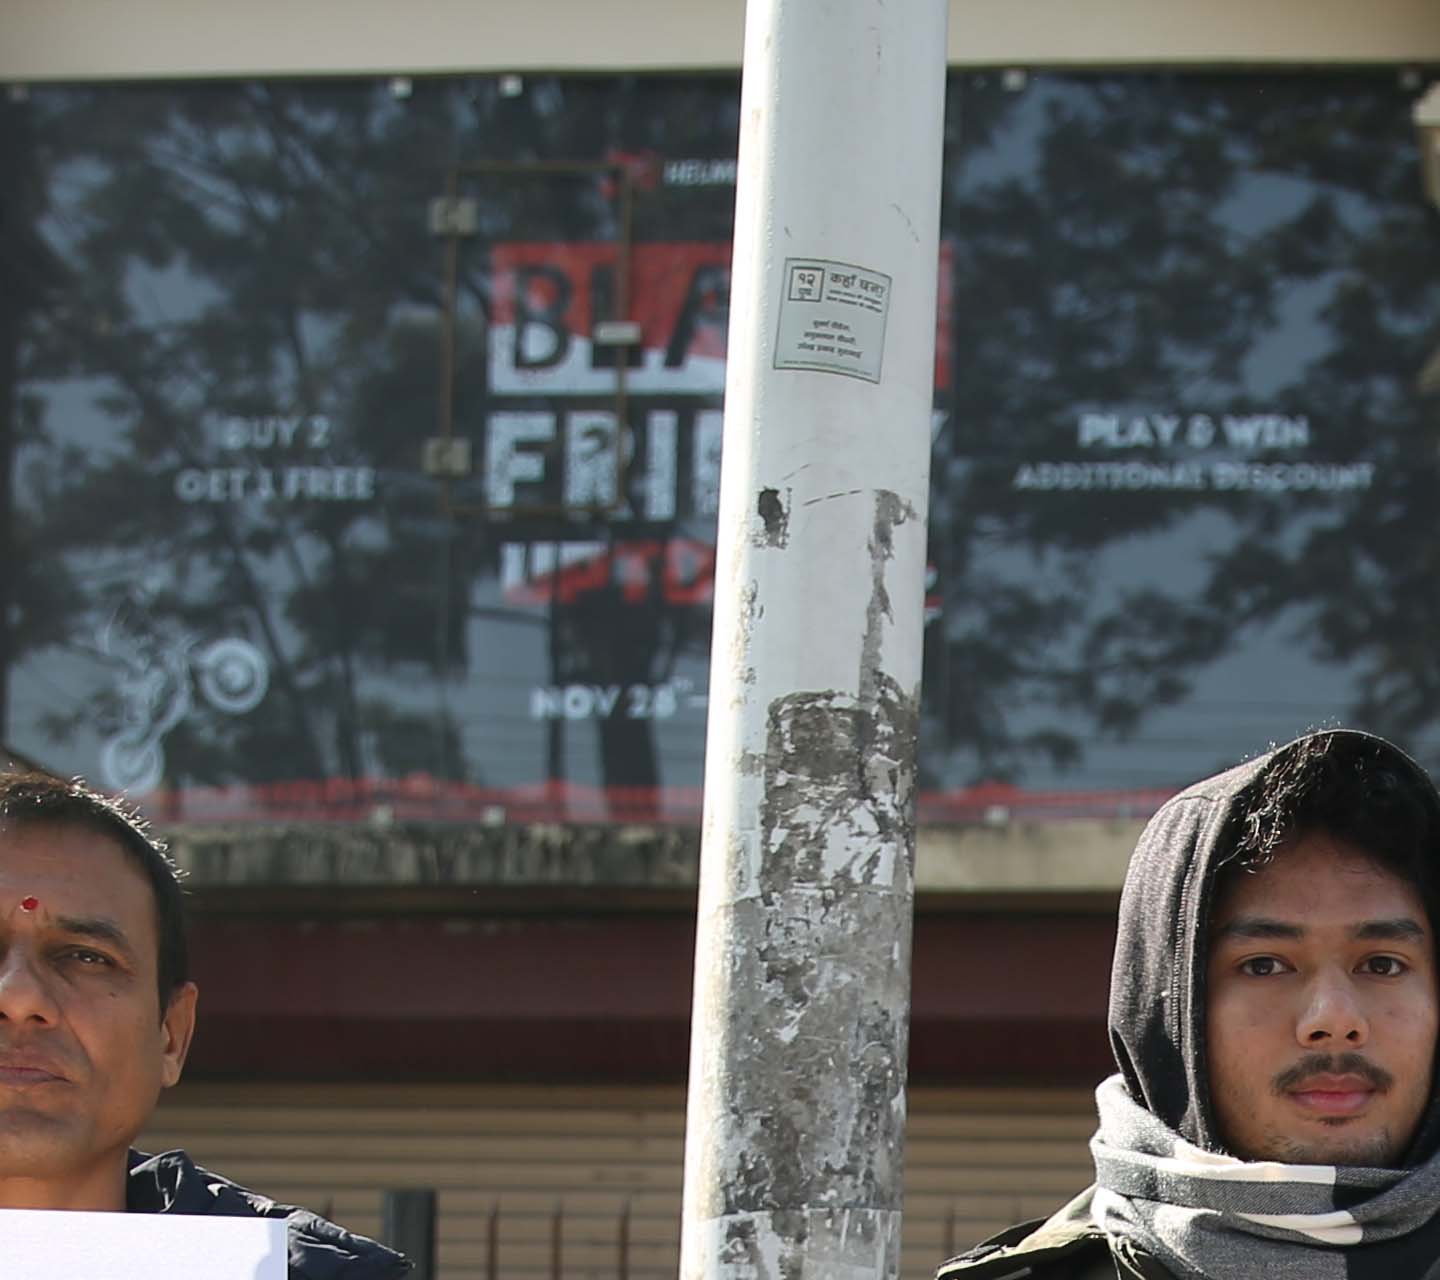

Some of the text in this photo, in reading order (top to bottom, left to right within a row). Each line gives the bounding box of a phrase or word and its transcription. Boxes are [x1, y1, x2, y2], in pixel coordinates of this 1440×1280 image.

[510, 262, 730, 369] BLA
[1078, 413, 1179, 448] PLAY
[1222, 414, 1310, 448] WIN
[284, 467, 377, 500] FREE
[1014, 461, 1375, 492] ADDITIONAL DISCOUNT
[530, 684, 621, 719] NOV
